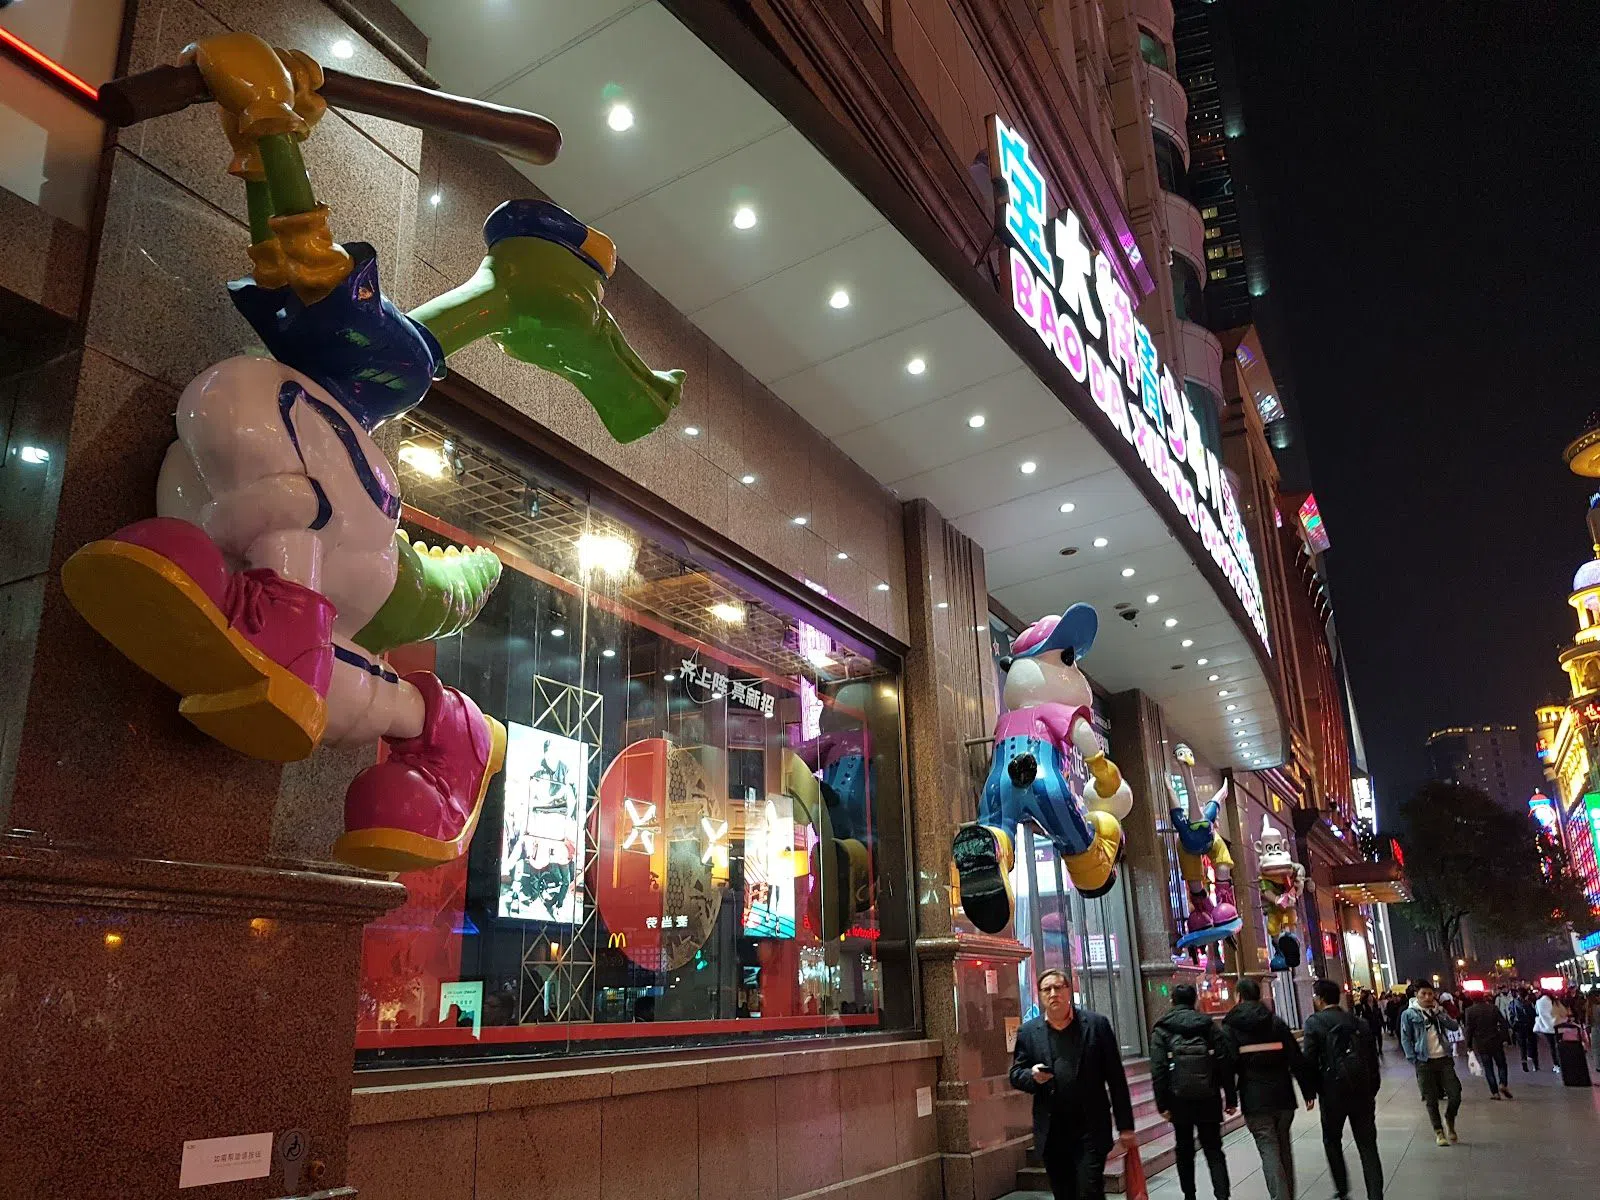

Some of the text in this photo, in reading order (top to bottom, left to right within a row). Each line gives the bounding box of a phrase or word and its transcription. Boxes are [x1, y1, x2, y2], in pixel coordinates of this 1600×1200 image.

[1009, 247, 1087, 383] BAO
[730, 681, 775, 714] 亮新招
